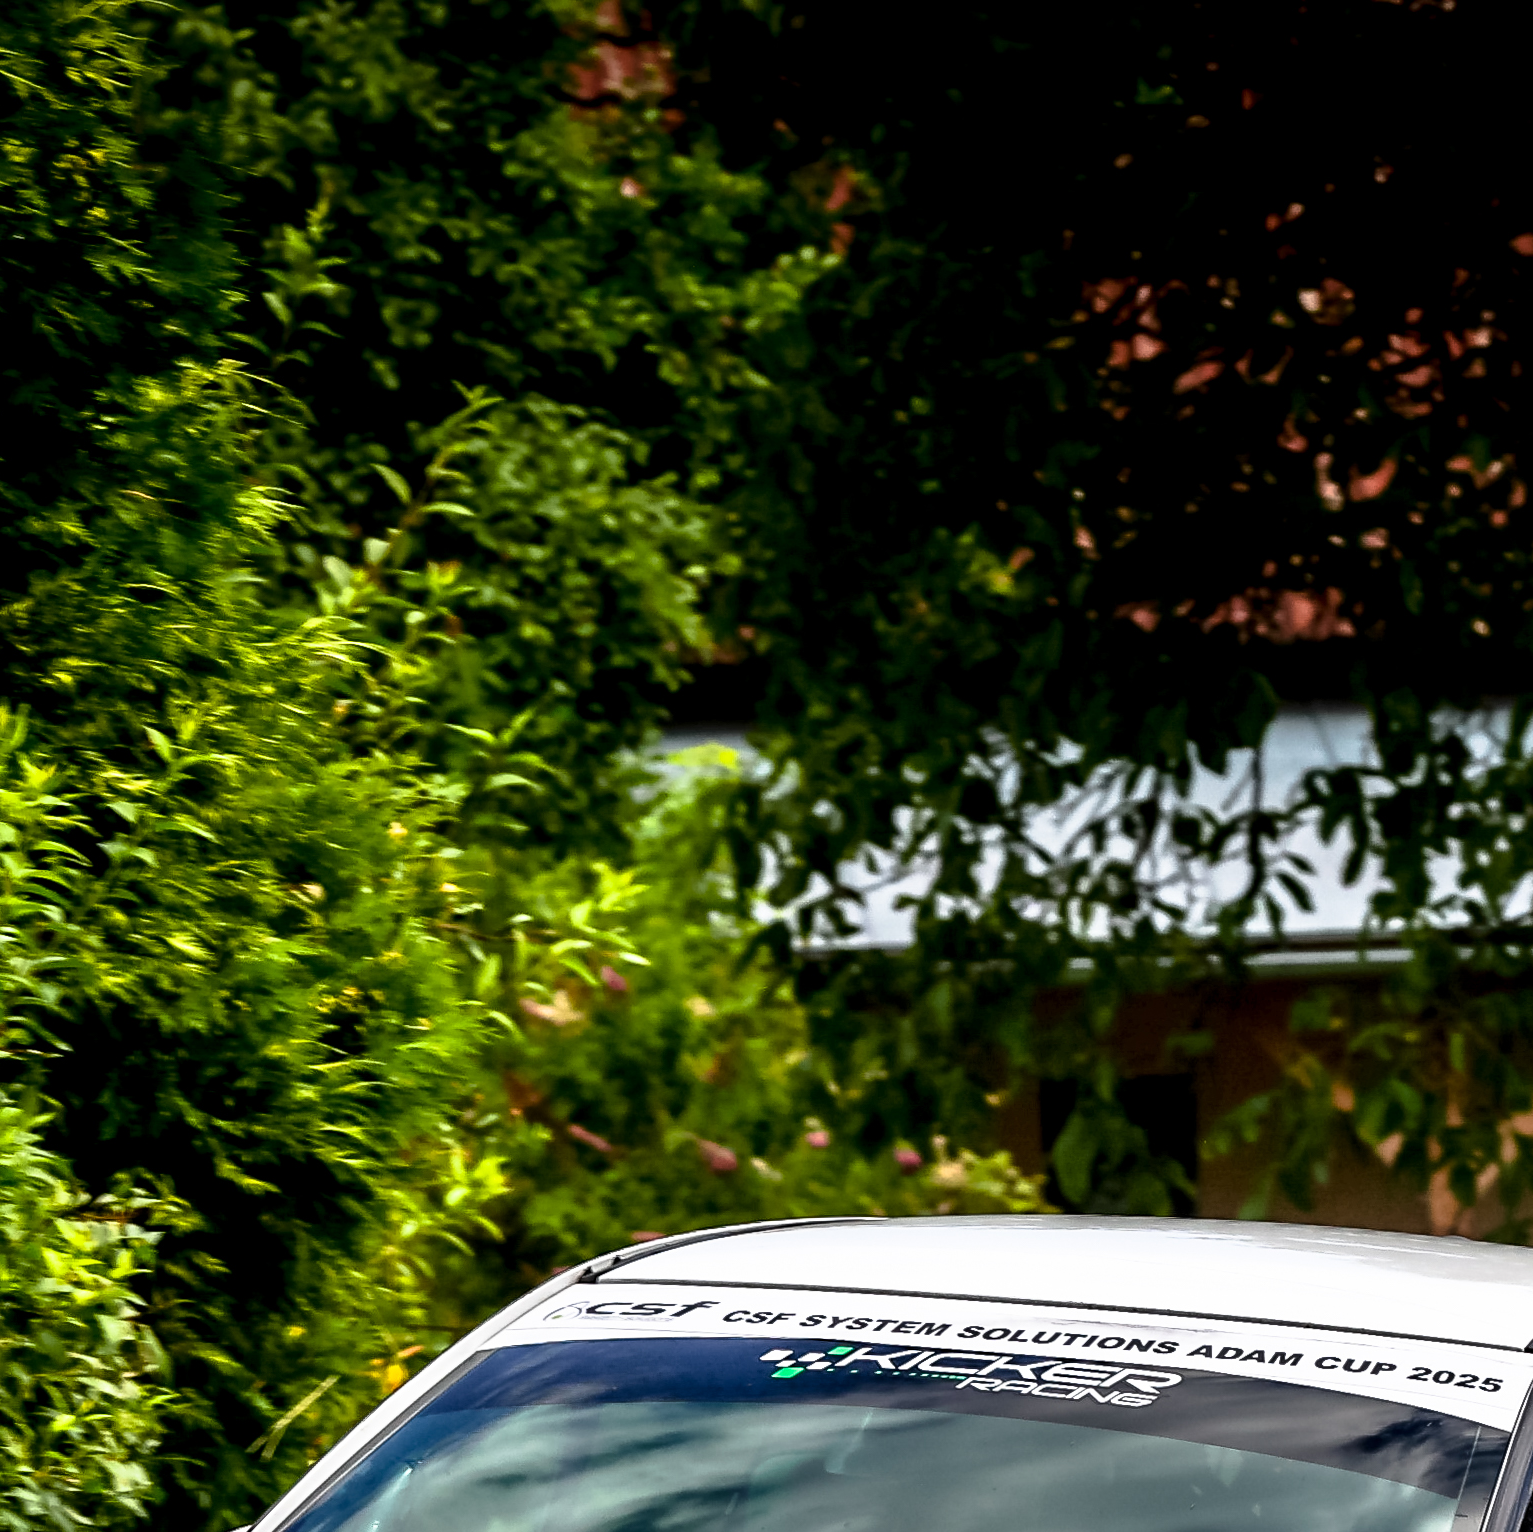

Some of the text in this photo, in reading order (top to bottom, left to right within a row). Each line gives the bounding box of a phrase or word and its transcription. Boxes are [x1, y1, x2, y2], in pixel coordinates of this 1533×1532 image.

[722, 1310, 1504, 1393] CSF SYSTEM SOLUTIONS ADAM CUP 2025
[834, 1347, 1183, 1394] KICKER
[955, 1377, 1159, 1407] RACING
